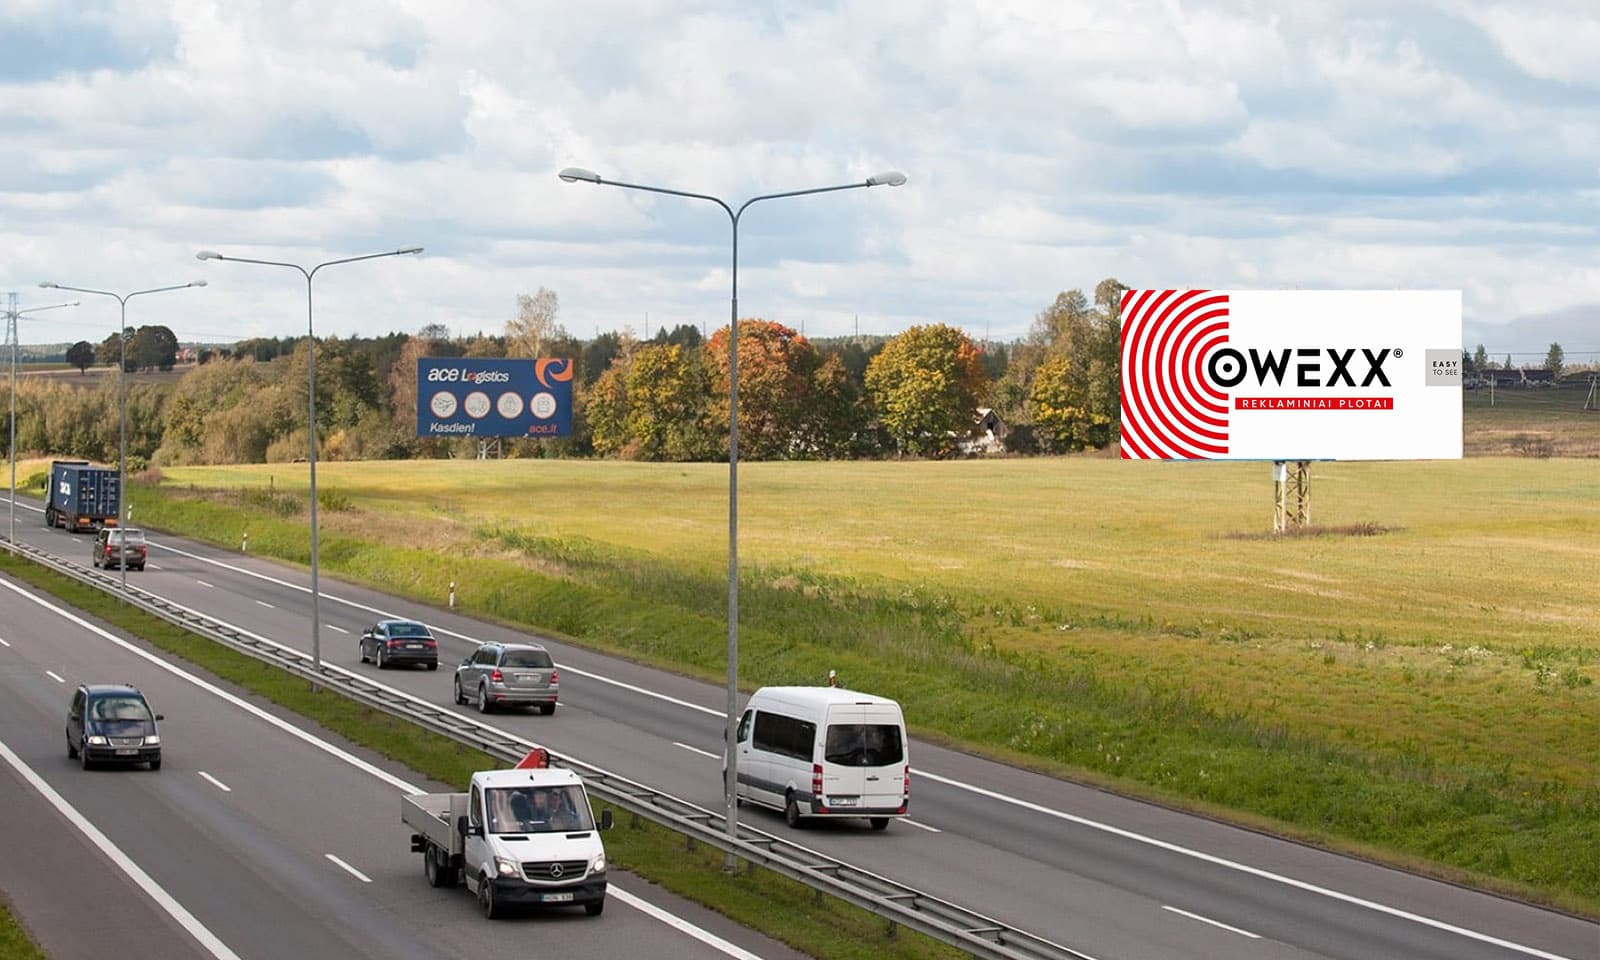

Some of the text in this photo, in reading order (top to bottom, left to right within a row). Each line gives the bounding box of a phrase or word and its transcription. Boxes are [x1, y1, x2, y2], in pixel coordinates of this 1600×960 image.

[1432, 360, 1458, 368] EASY
[427, 367, 510, 385] ace Logistics
[1242, 399, 1388, 408] REKLAMINIAI PLOTAI
[429, 422, 476, 433] Kasdien!
